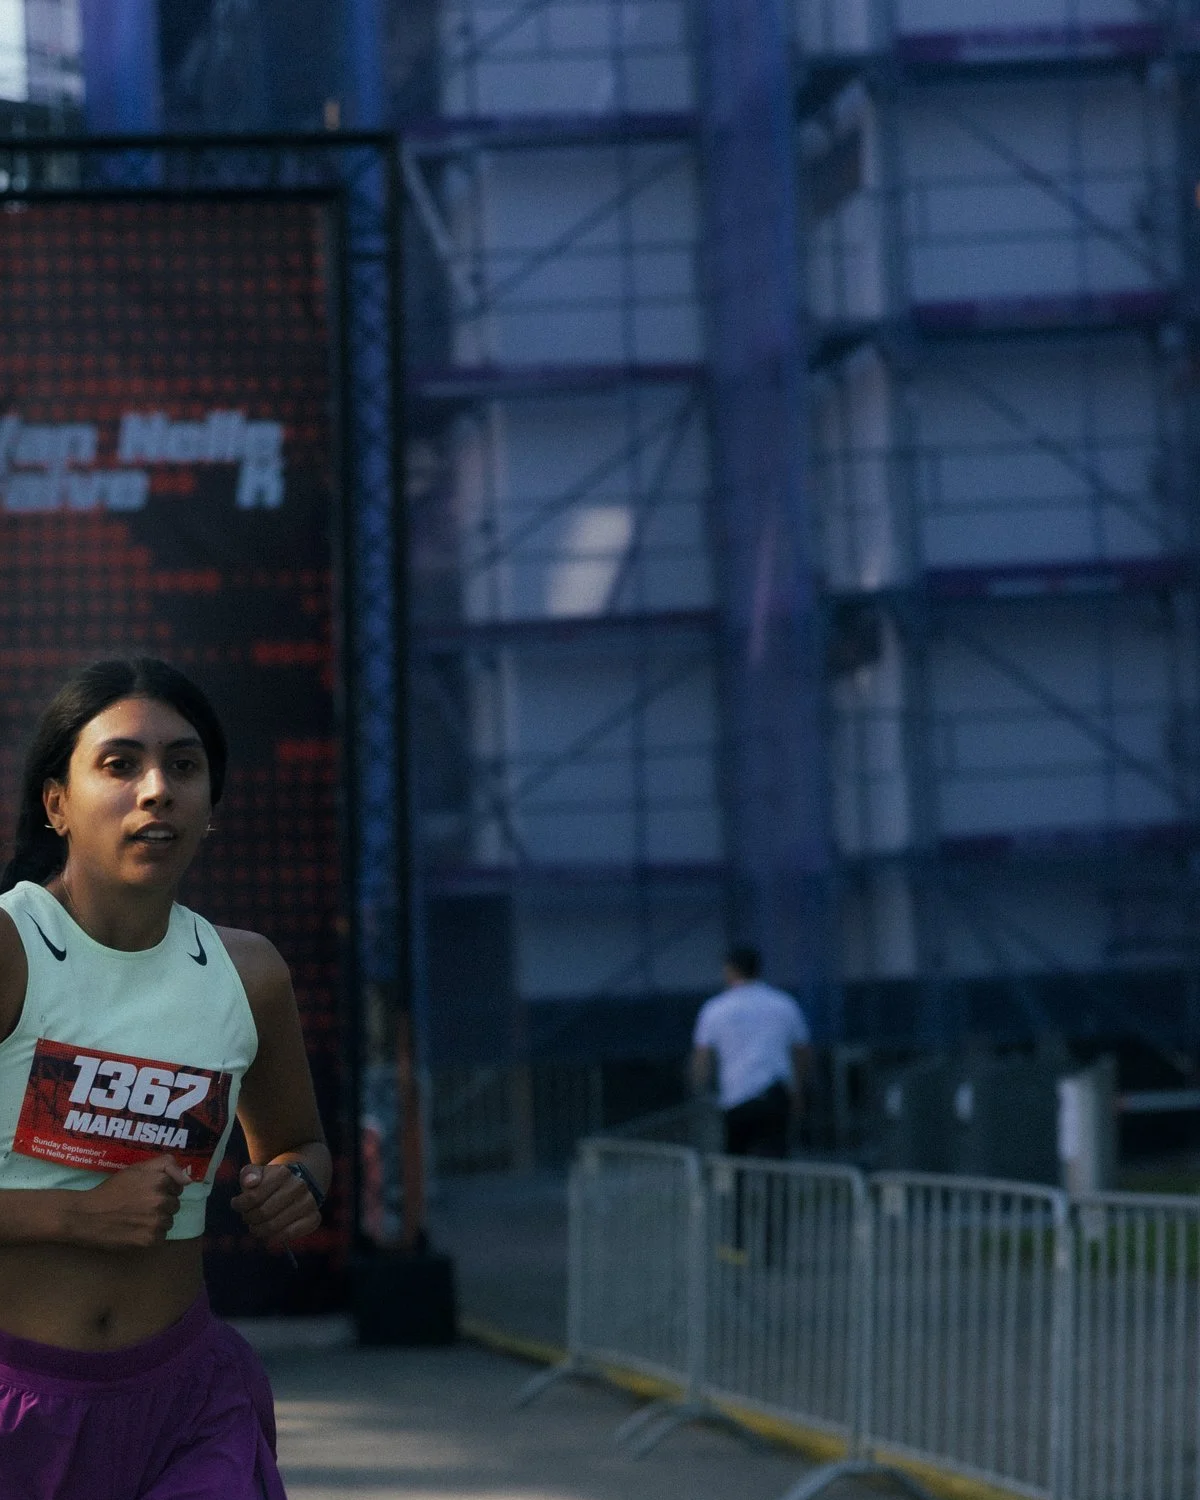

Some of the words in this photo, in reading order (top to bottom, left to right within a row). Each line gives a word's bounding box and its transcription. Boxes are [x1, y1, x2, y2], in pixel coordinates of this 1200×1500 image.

[69, 1055, 211, 1119] 1367
[63, 1110, 188, 1148] MARLISHA
[32, 1145, 45, 1154] Van
[46, 1149, 64, 1159] Nelle
[66, 1153, 93, 1164] Fabriek
[33, 1136, 61, 1149] Sunday
[62, 1143, 101, 1157] September
